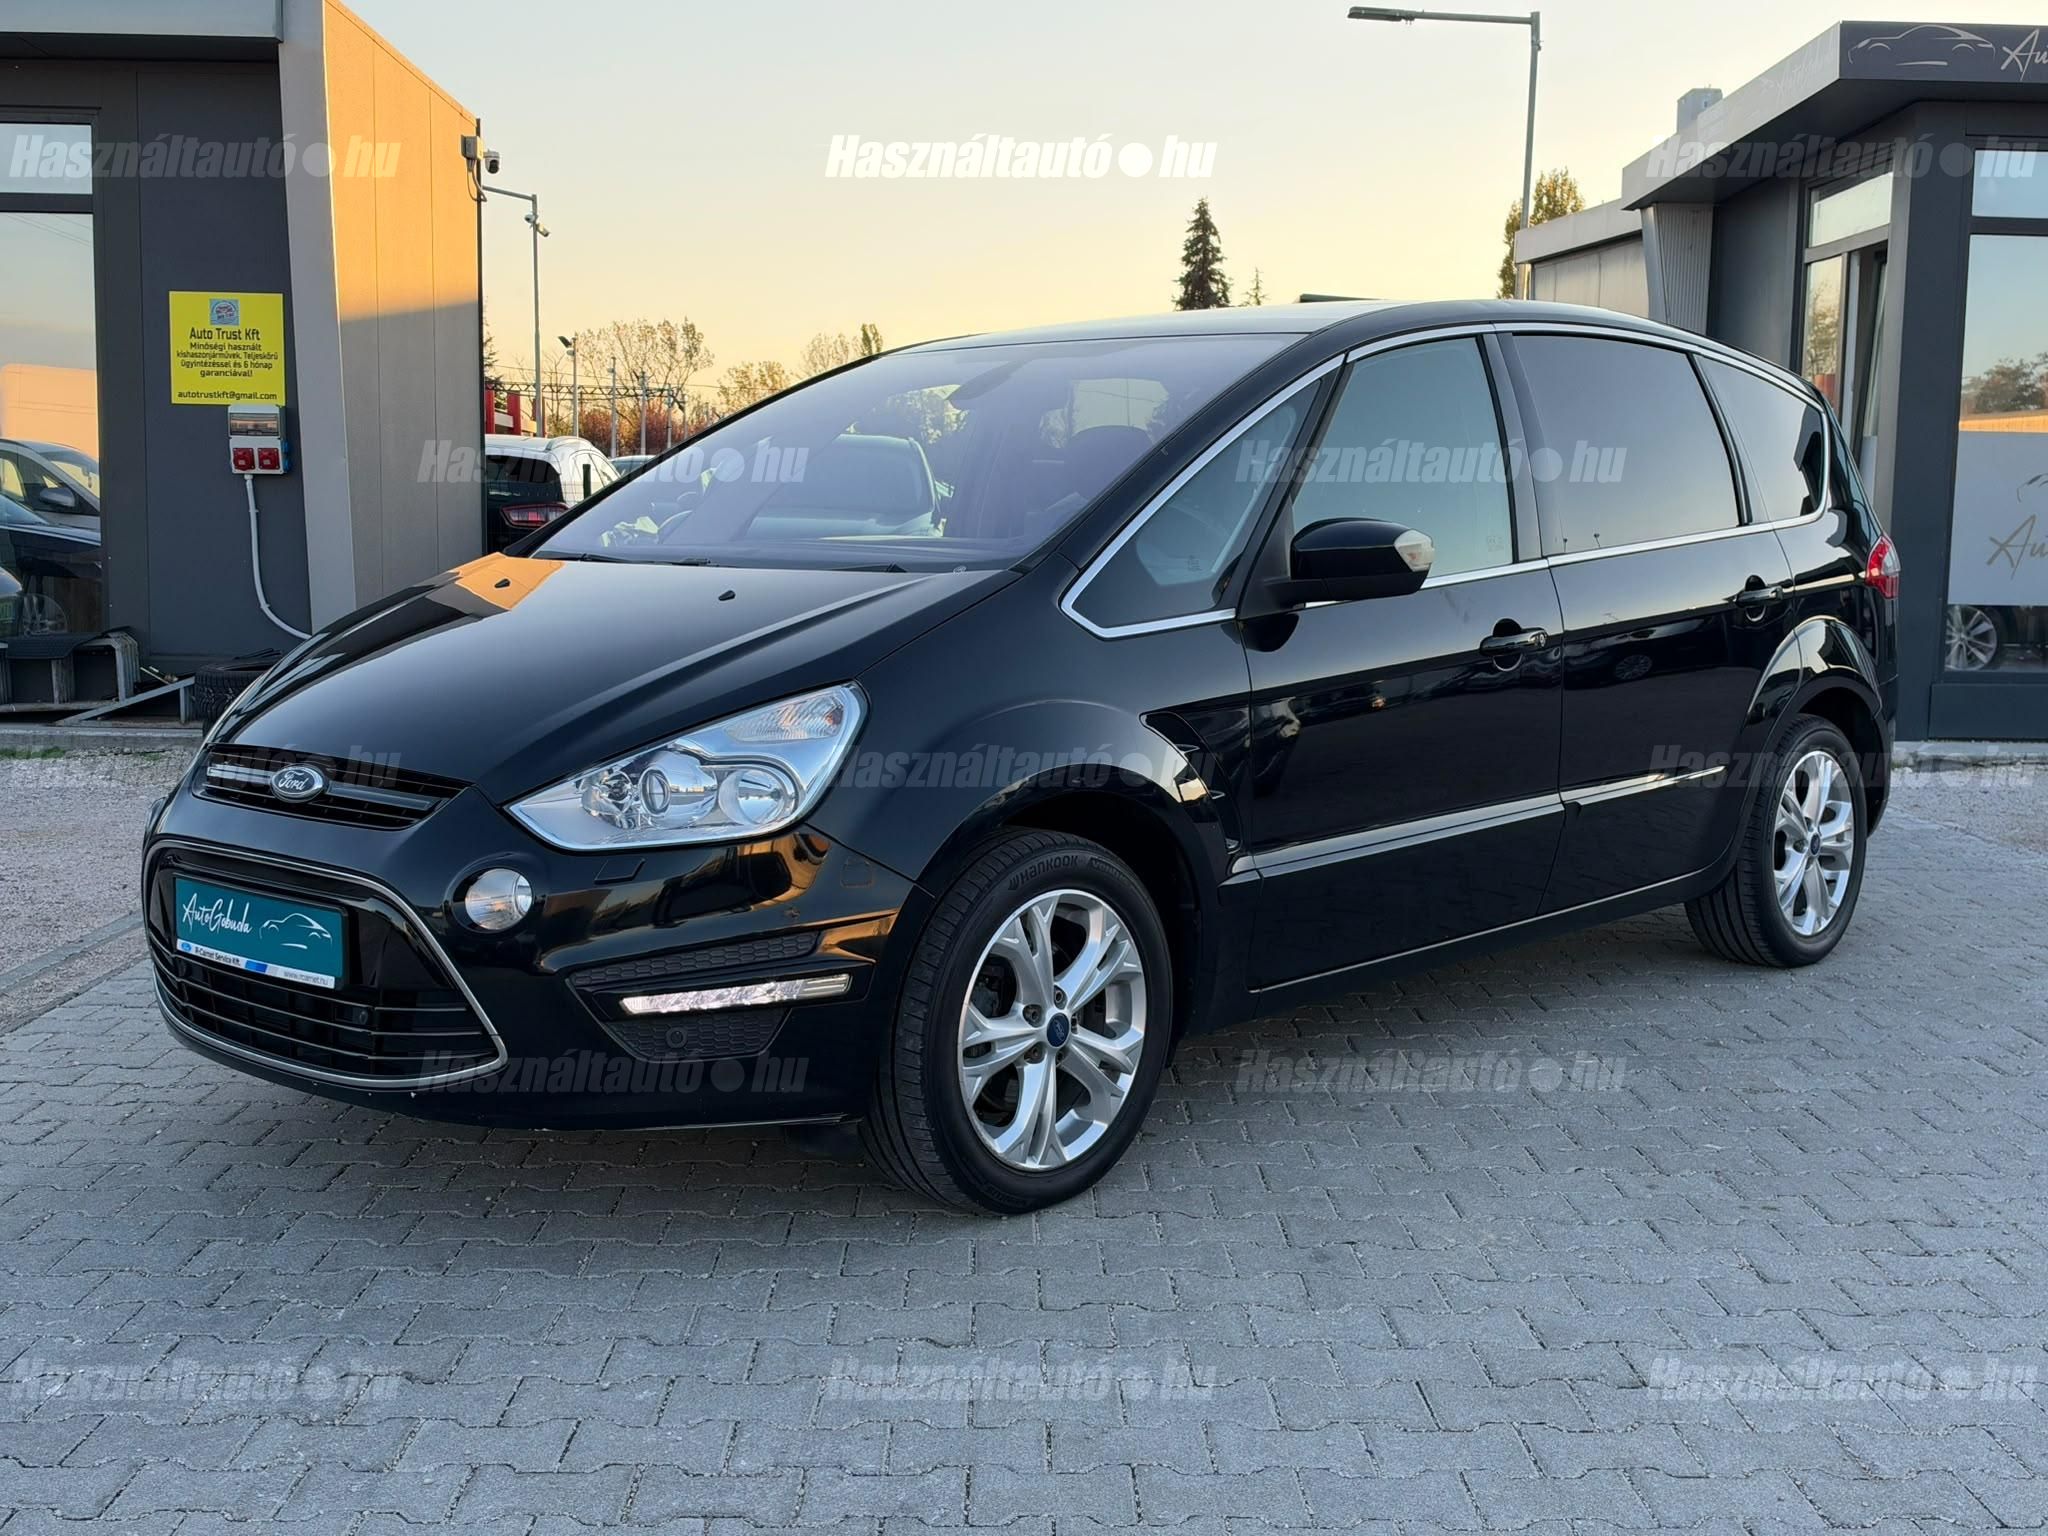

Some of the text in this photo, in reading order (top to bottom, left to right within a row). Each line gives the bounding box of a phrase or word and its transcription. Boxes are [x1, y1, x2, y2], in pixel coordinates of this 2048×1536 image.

[189, 327, 260, 340] Auto Trust Kft
[228, 343, 262, 351] használt
[233, 360, 242, 368] és
[243, 360, 249, 368] 6
[250, 360, 273, 370] hónap
[177, 390, 278, 400] autotrustkft@gmail.com
[278, 770, 309, 790] Ford
